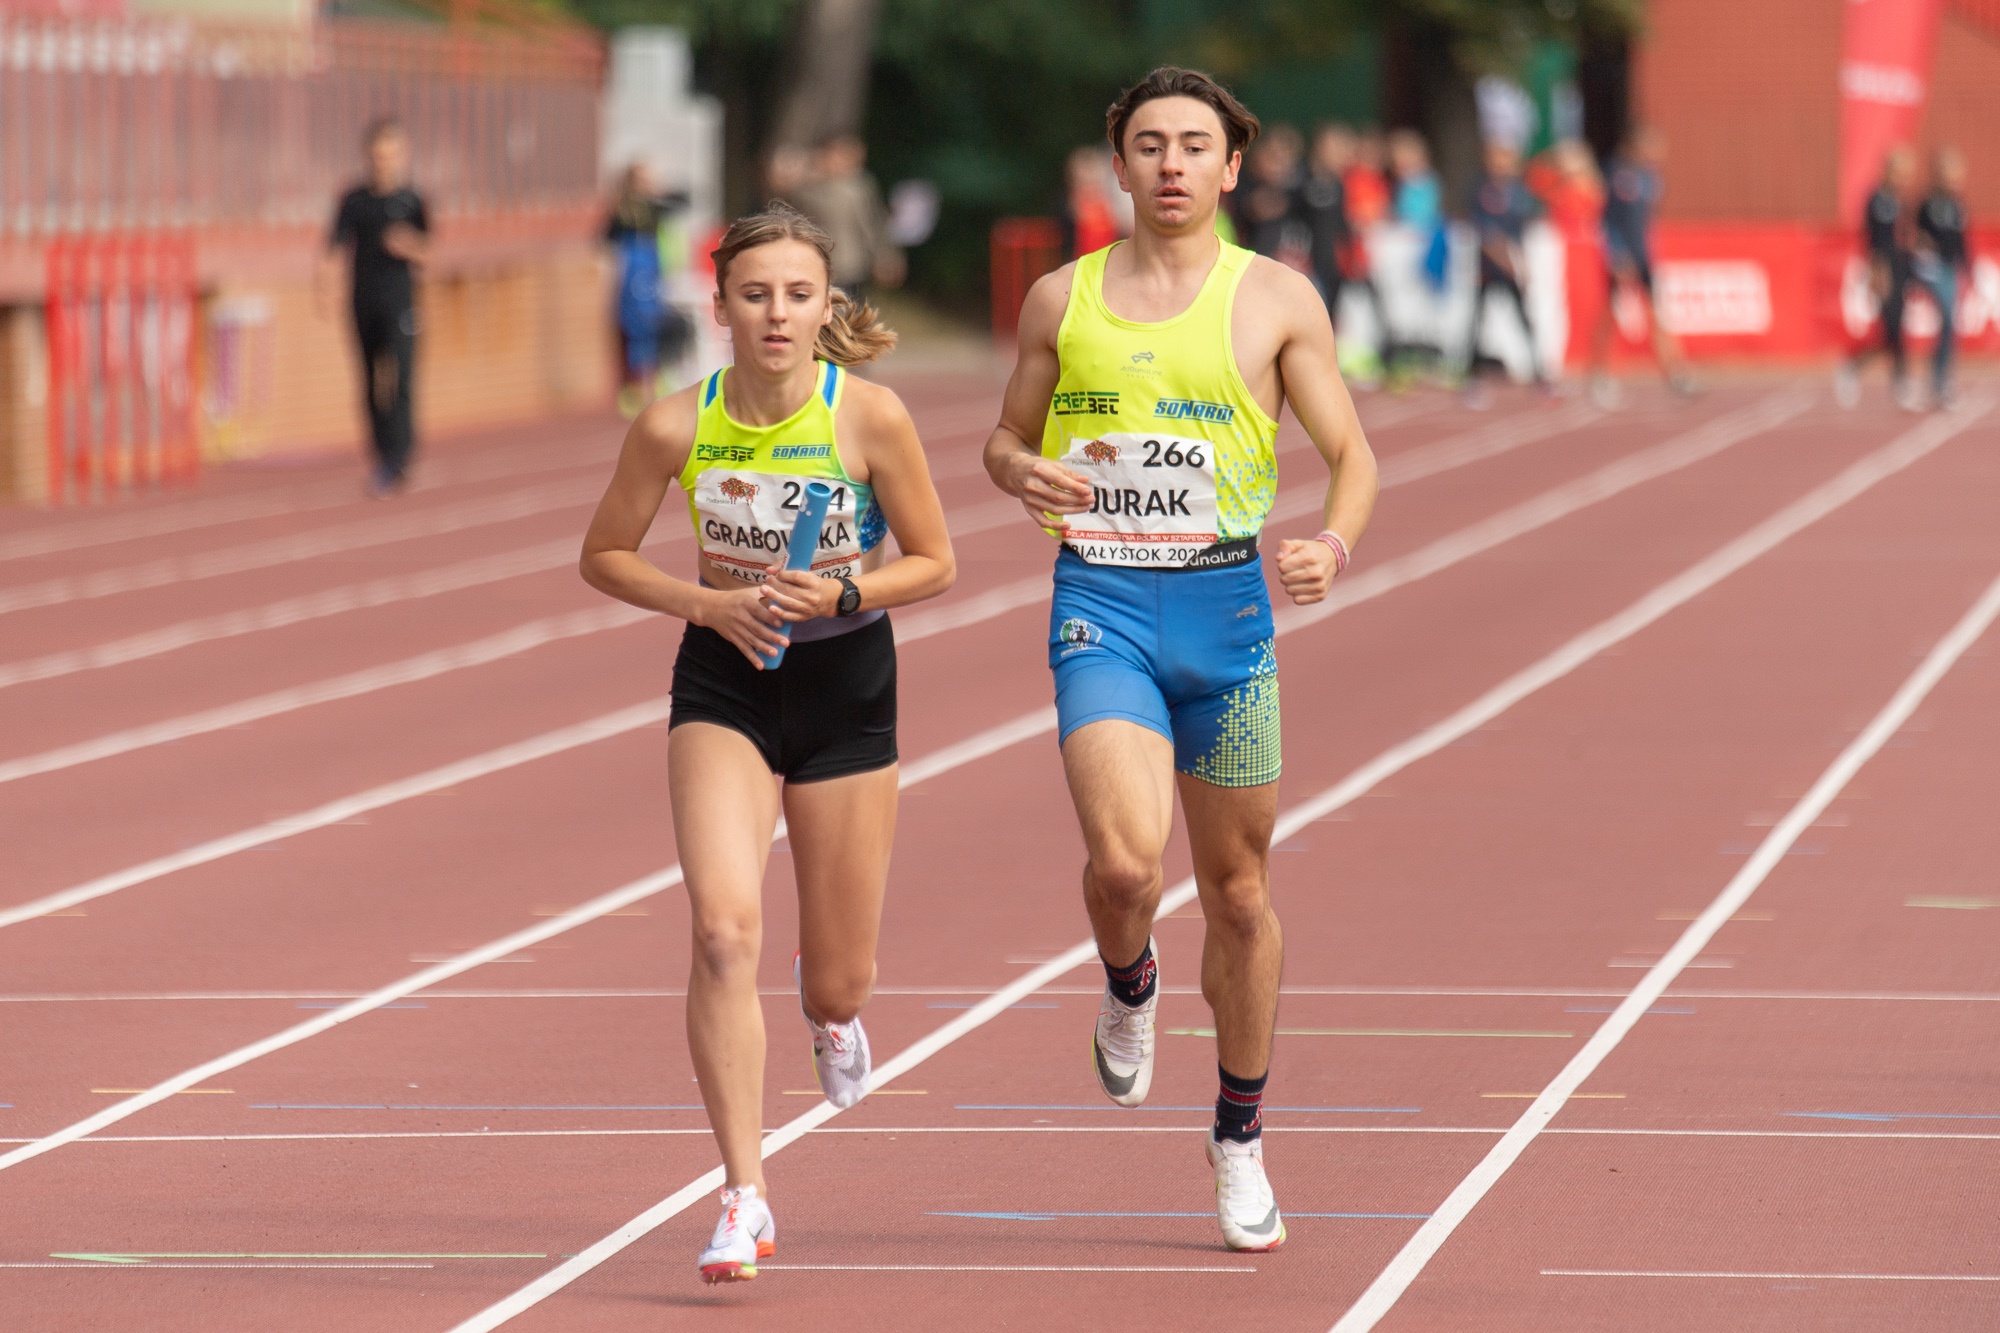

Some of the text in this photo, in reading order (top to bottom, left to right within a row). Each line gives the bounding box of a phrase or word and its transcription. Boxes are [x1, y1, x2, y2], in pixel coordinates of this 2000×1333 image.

[1154, 399, 1235, 424] SONAROL
[771, 445, 832, 460] SONAROL
[1142, 440, 1206, 469] 266
[781, 481, 846, 512] 24
[1089, 485, 1192, 517] JURAK
[704, 519, 851, 554] GRABOKA
[1065, 531, 1085, 539] PZLA
[1170, 535, 1215, 543] SZTAFETACH
